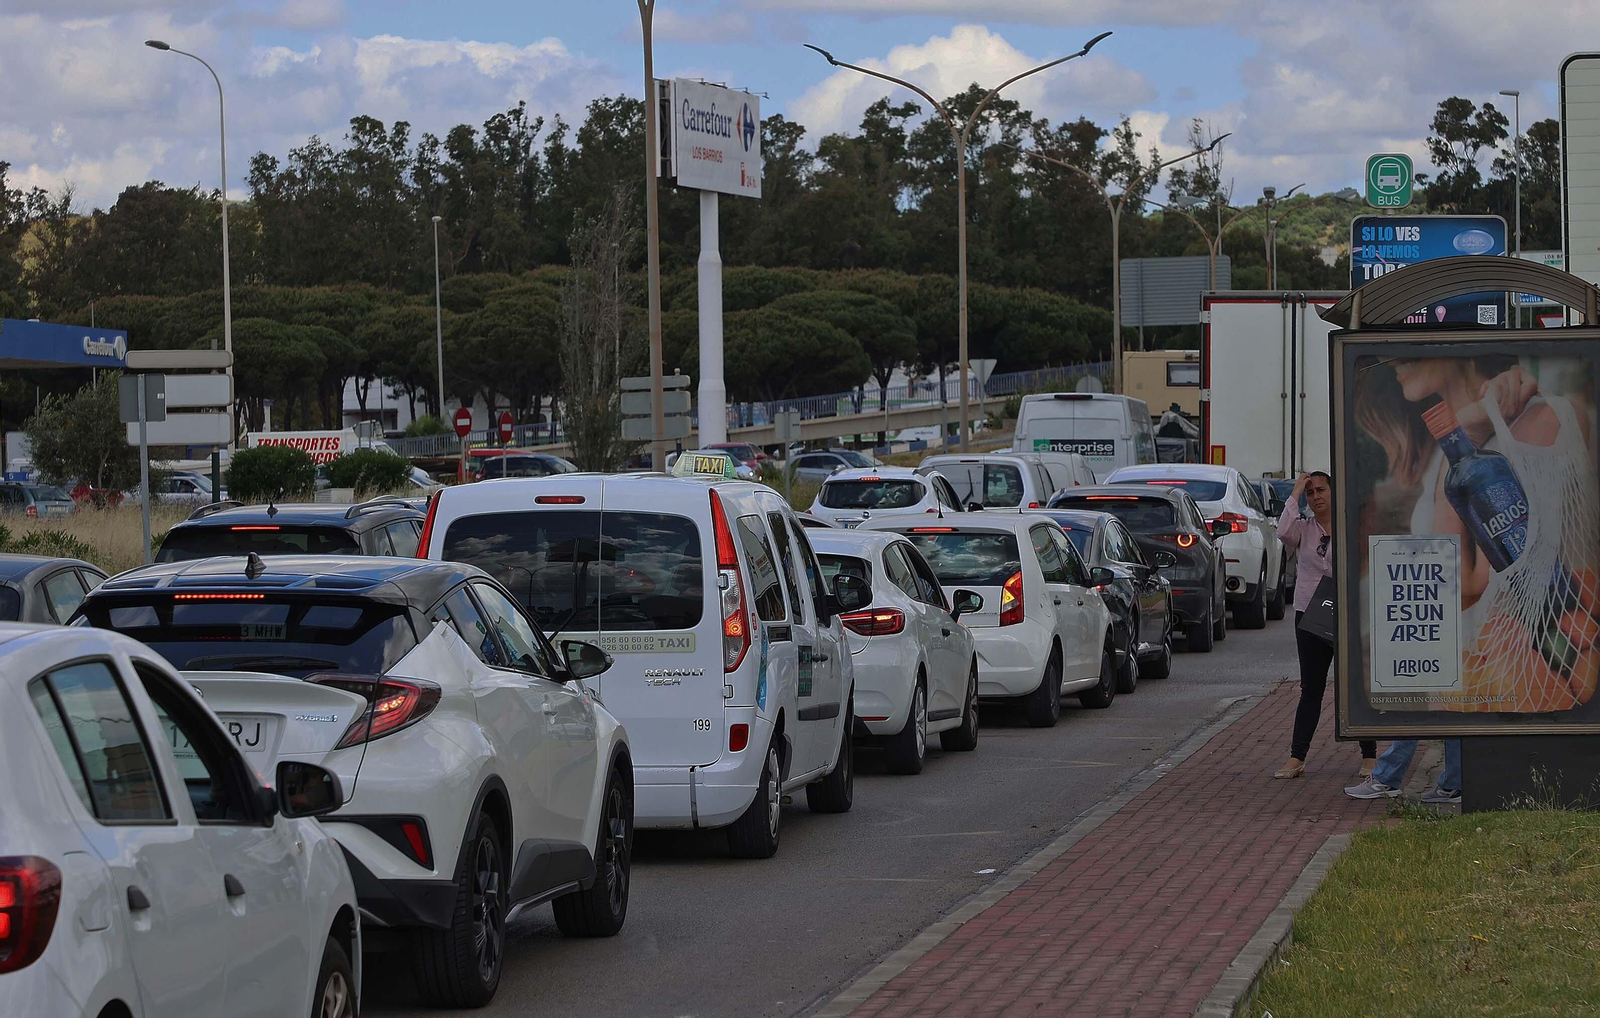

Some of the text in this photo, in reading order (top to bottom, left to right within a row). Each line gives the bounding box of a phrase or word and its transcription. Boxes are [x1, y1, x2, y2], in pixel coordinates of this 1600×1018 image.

[682, 98, 732, 138] Carrefour
[692, 146, 723, 164] LOS BARRIOS
[1377, 196, 1401, 206] BUS
[1361, 226, 1420, 241] SI LO VES
[1361, 244, 1420, 259] LO VEMOS
[1038, 441, 1114, 454] enterprise
[696, 457, 724, 474] TAXI
[1482, 500, 1528, 539] LARIOS
[1386, 563, 1447, 583] VIVIR
[1392, 583, 1439, 602] BIEN
[601, 636, 655, 644] 956 60 60 60
[1390, 624, 1440, 642] ARTE
[631, 643, 642, 651] 60
[644, 643, 655, 651] 62
[657, 638, 690, 648] TAXI
[644, 667, 706, 677] RENAULT
[1393, 659, 1440, 677] LARIOS
[645, 678, 682, 687] TECH
[1371, 696, 1401, 704] DISFRUTA
[1425, 695, 1460, 703] CONSUMO
[692, 718, 711, 731] 199
[222, 721, 261, 747] RJ
